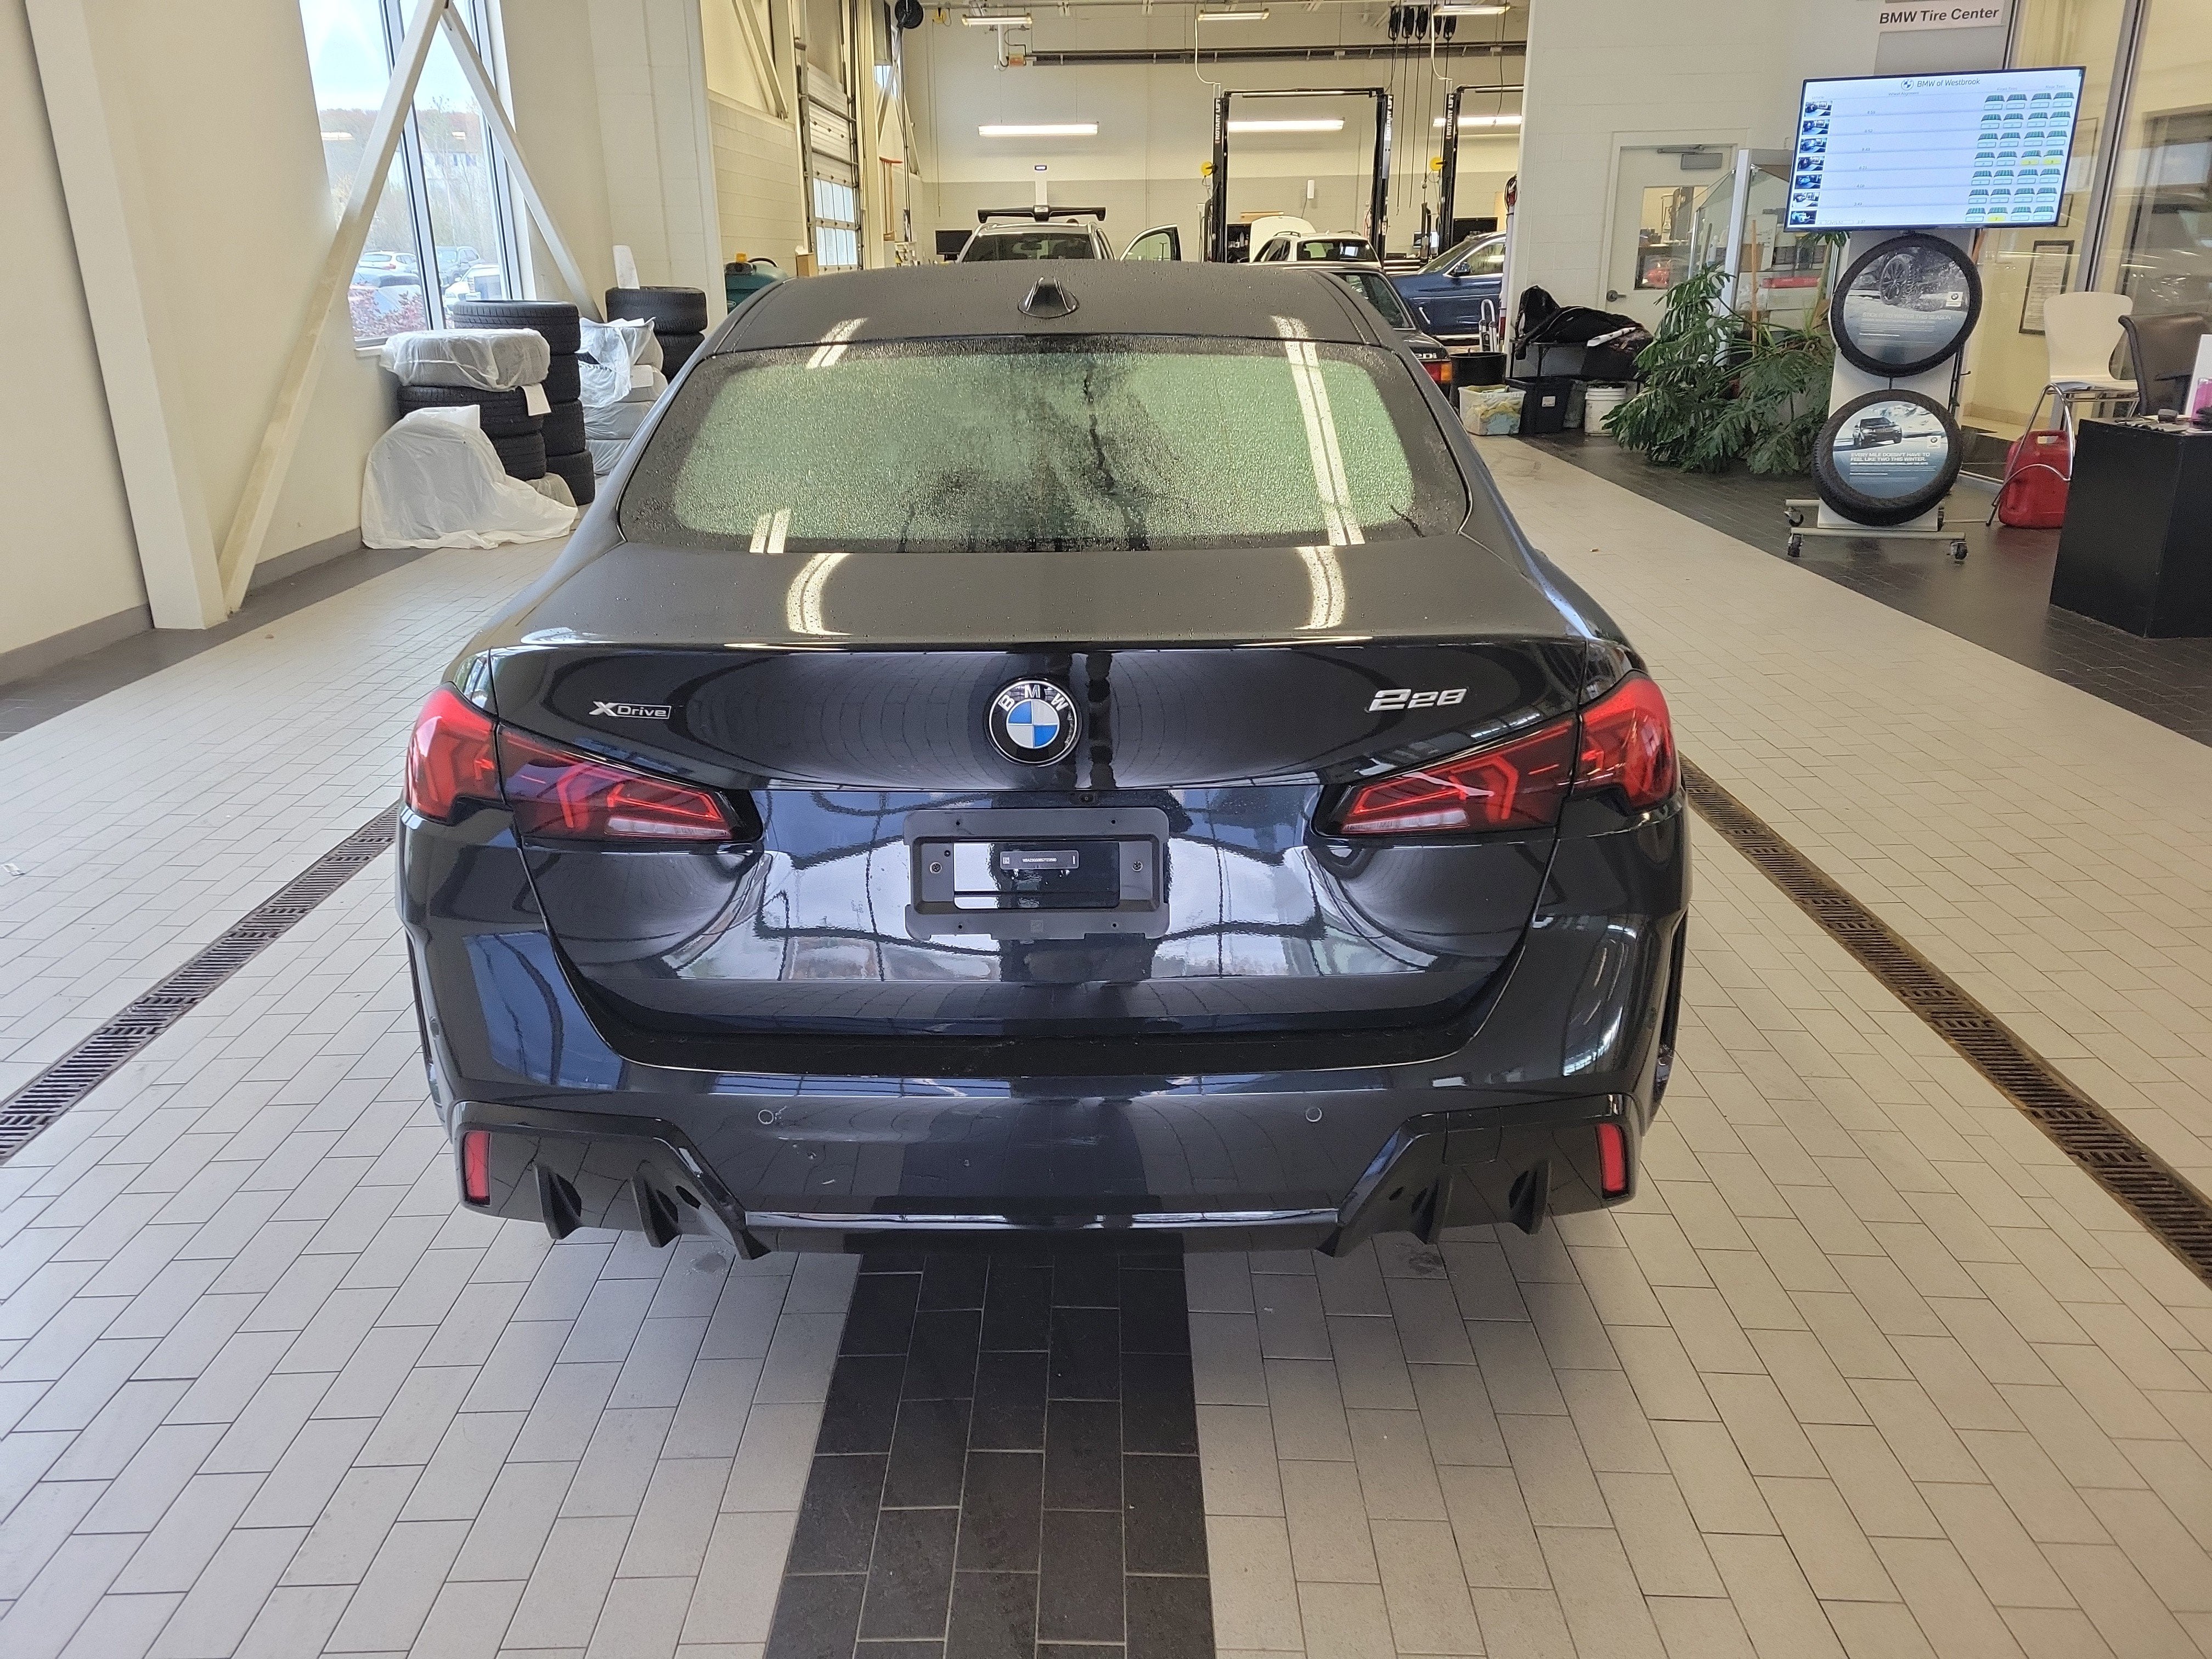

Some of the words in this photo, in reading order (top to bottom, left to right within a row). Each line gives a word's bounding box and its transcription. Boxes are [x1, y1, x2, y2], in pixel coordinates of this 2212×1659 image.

[1880, 11, 1917, 24] BMW
[1920, 10, 1947, 21] Tire
[1951, 8, 2000, 20] Center
[997, 684, 1069, 712] BMW
[1368, 689, 1468, 712] 228
